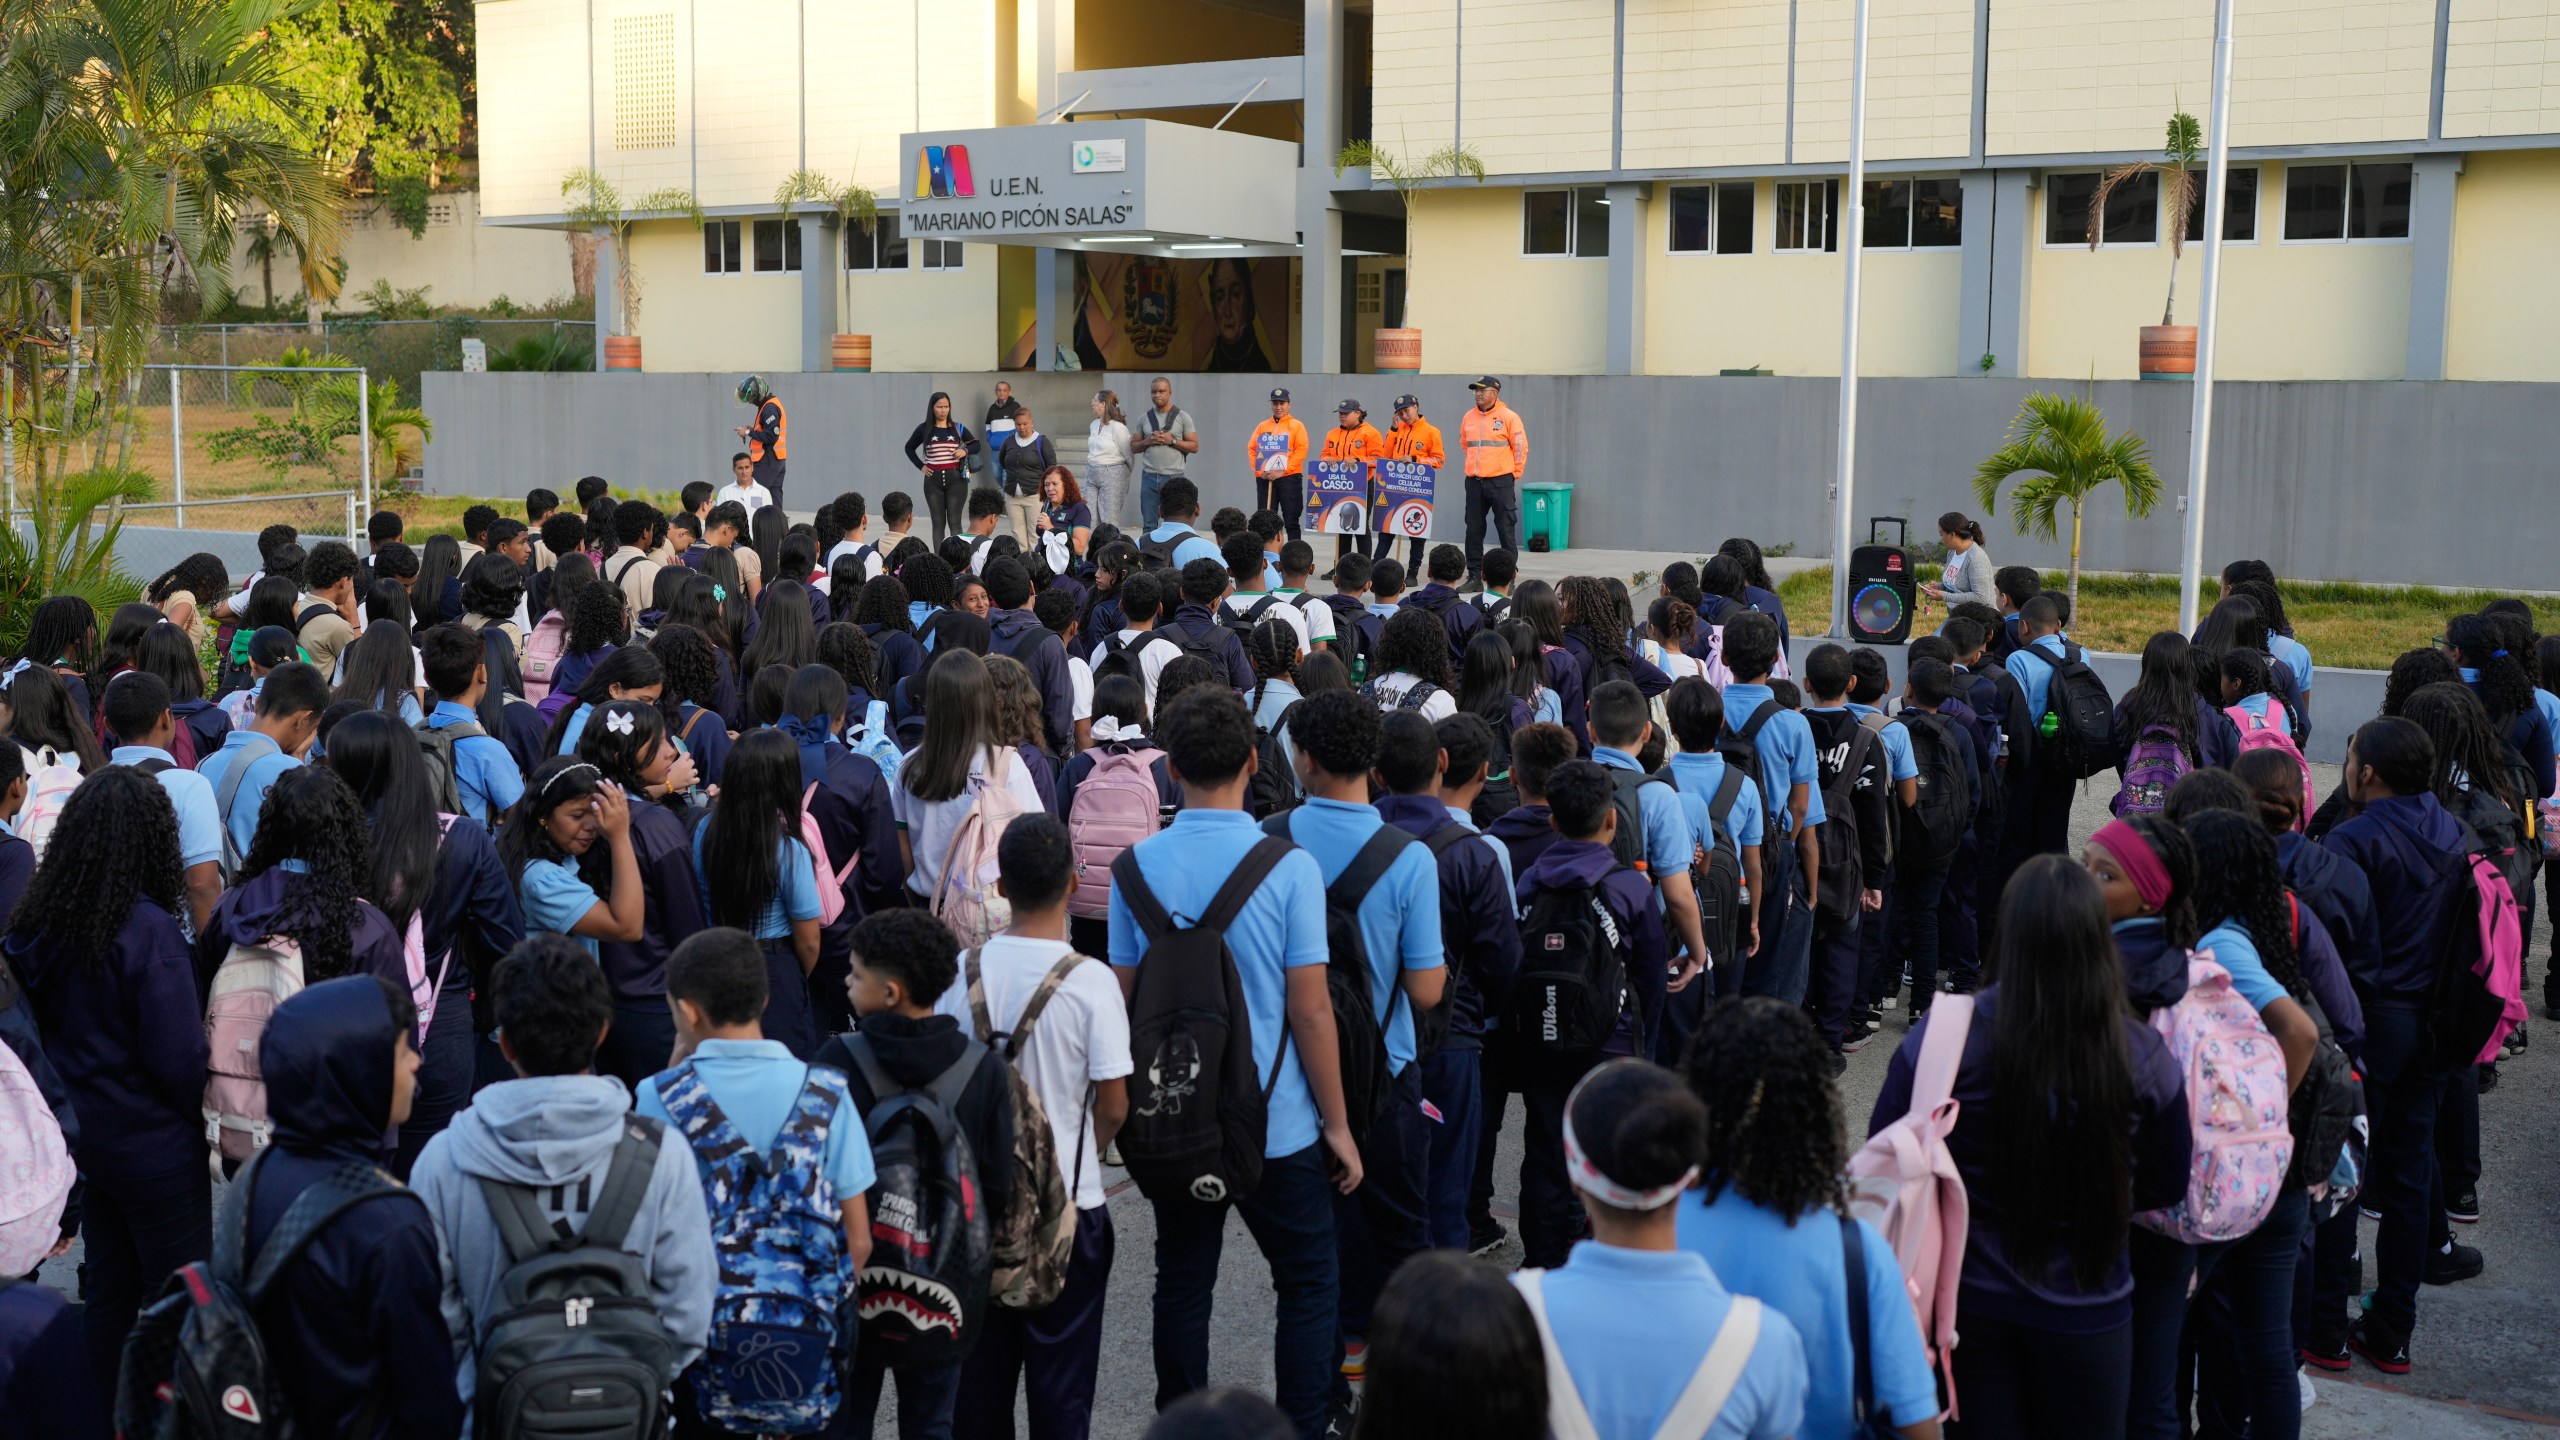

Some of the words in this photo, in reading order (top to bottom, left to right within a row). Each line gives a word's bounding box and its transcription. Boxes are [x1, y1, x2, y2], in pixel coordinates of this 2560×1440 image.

[990, 176, 1044, 197] U.E.N.
[907, 210, 996, 231] "MARIANO
[1001, 203, 1059, 228] PICÓN
[1064, 205, 1133, 226] SALAS"
[1322, 480, 1354, 490] CASCO
[1386, 483, 1407, 492] MIENTRAS
[1408, 486, 1433, 495] CONDUCES
[1398, 479, 1421, 487] CELULAR
[1591, 896, 1620, 949] Wilson
[1542, 985, 1557, 1042] Wilson
